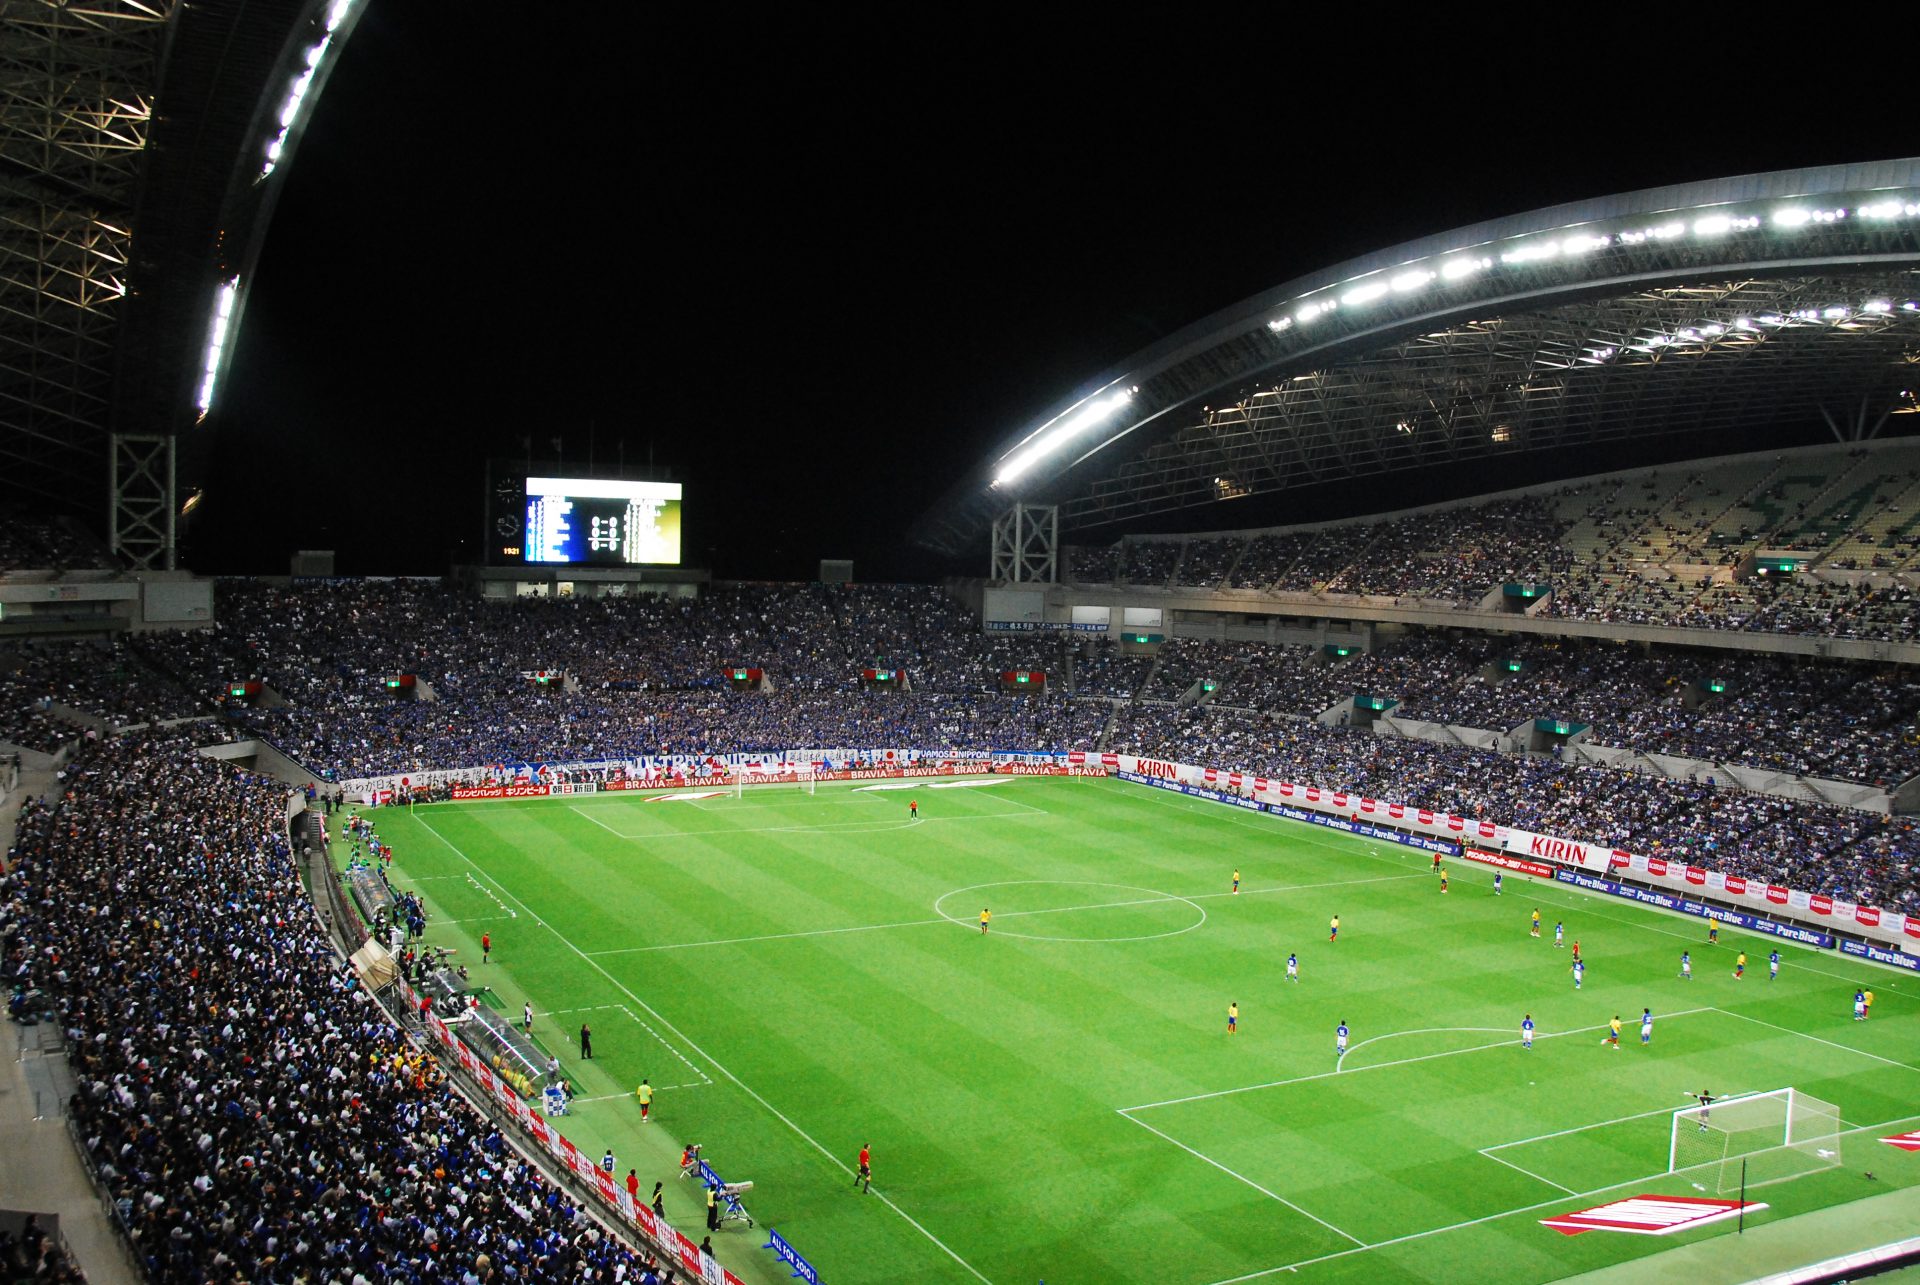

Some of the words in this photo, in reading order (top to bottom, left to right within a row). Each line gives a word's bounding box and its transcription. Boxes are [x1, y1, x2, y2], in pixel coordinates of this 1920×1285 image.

[851, 769, 888, 779] BRAVIA
[903, 767, 939, 777] BRAVIA
[954, 765, 989, 775] BRAVIA
[1012, 766, 1051, 775] BRAVIA
[1068, 767, 1108, 777] BRAVIA
[1136, 759, 1178, 779] KIRIN
[742, 774, 780, 784] BRAVIA
[797, 771, 835, 781] BRAVIA
[625, 779, 666, 789] BRAVIA
[684, 776, 724, 787] BRAVIA
[505, 786, 547, 797] キリンビール
[552, 783, 594, 793] 朝日新聞
[1530, 836, 1587, 865] KIRIN
[1611, 854, 1630, 864] KIRIN
[1648, 862, 1667, 872] KIRIN
[1687, 871, 1705, 881] KIRIN
[1726, 880, 1746, 890] KIRIN
[1768, 889, 1788, 899] KIRIN
[1811, 899, 1832, 910] KIRIN
[1857, 910, 1879, 922] KIRIN
[771, 1235, 783, 1253] ALL
[782, 1247, 795, 1264] FOR
[795, 1258, 815, 1284] 2010!
